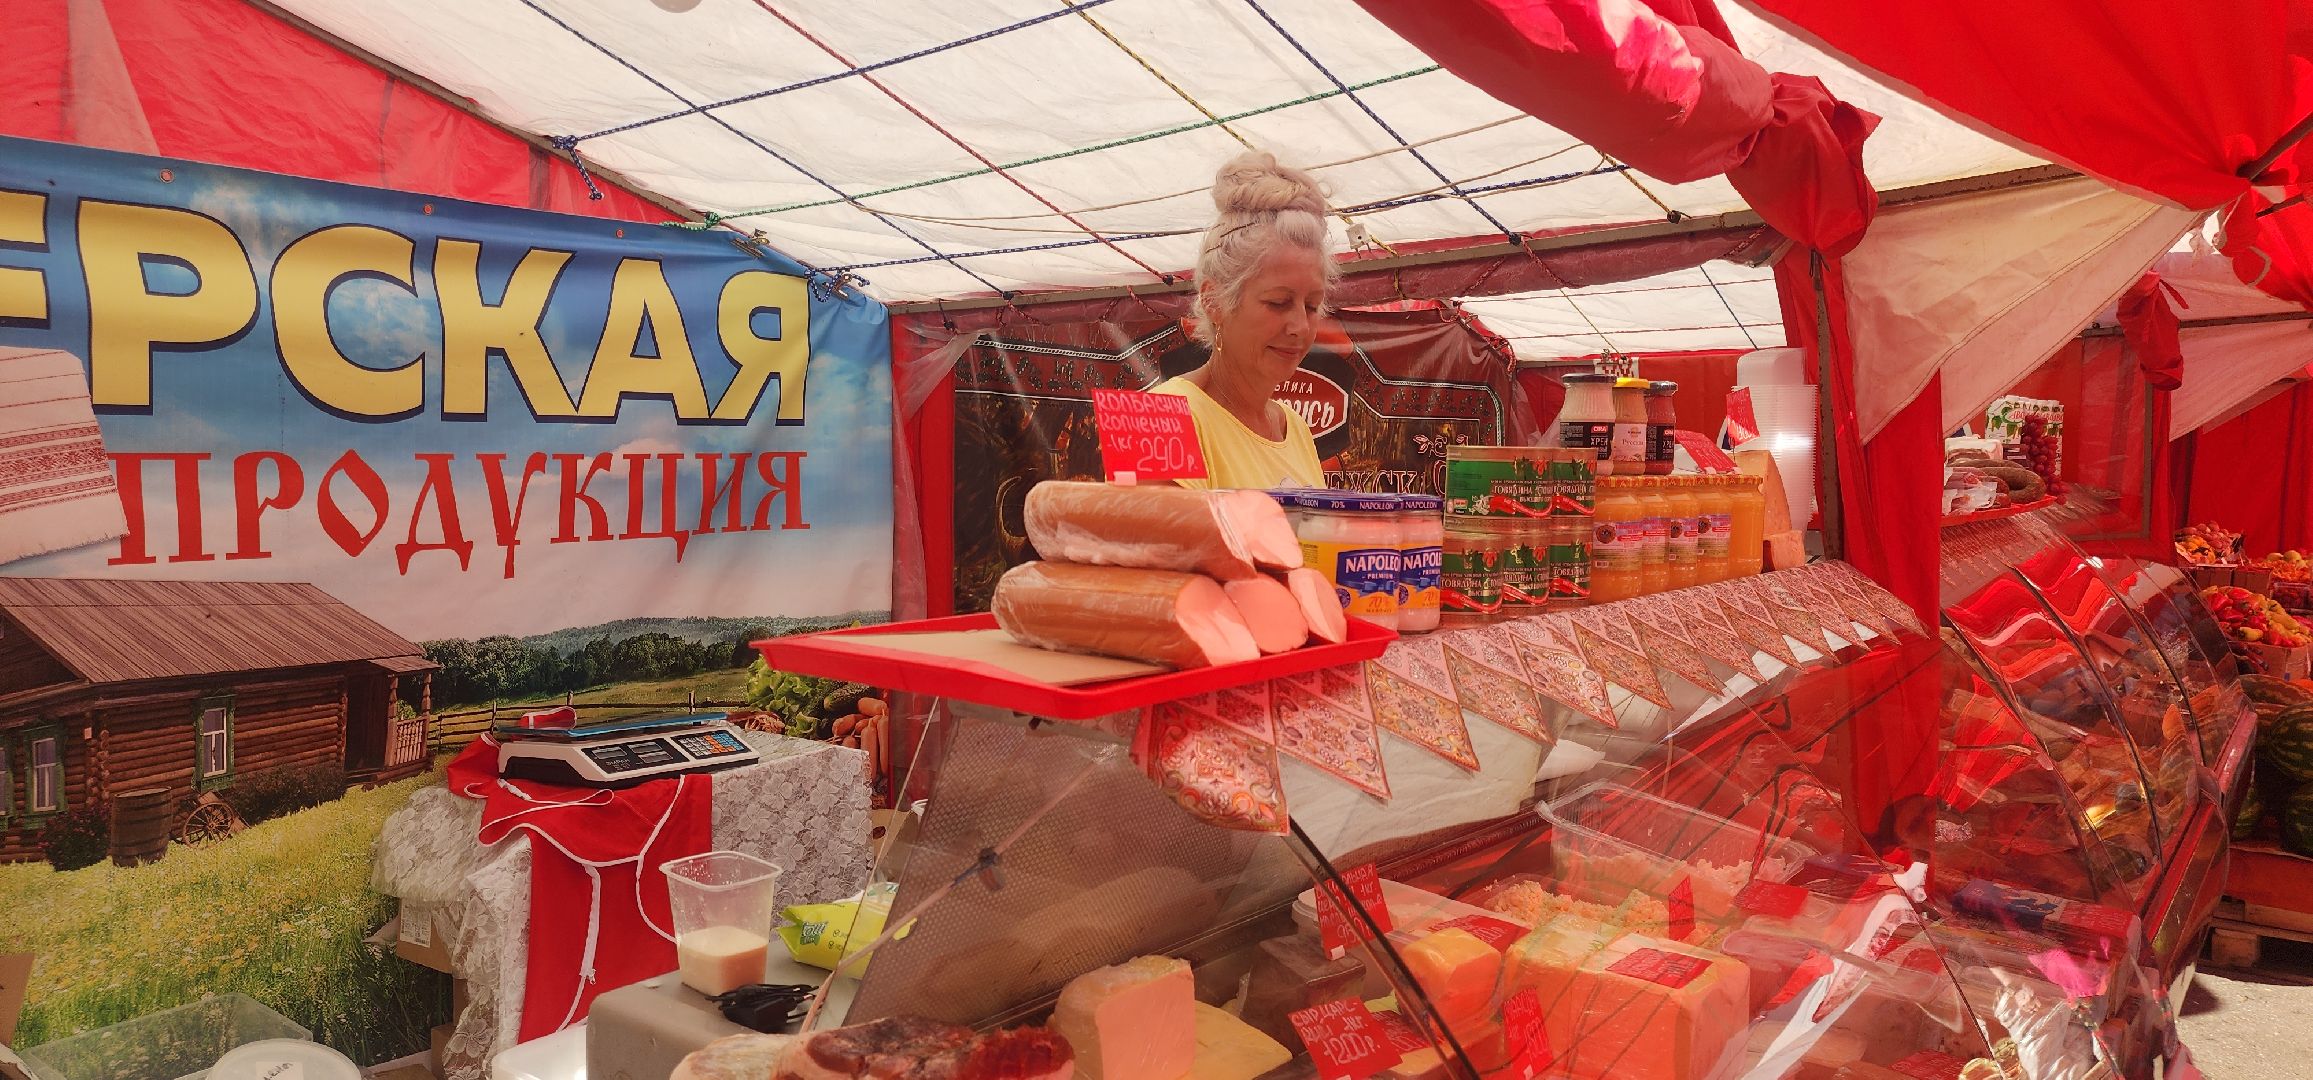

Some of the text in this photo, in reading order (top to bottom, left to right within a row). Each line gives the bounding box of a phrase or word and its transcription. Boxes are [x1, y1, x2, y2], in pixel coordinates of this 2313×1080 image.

[1137, 435, 1185, 473] 290
[108, 448, 811, 579] ПРОДУКЦИЯ
[1292, 1007, 1319, 1027] СЫР
